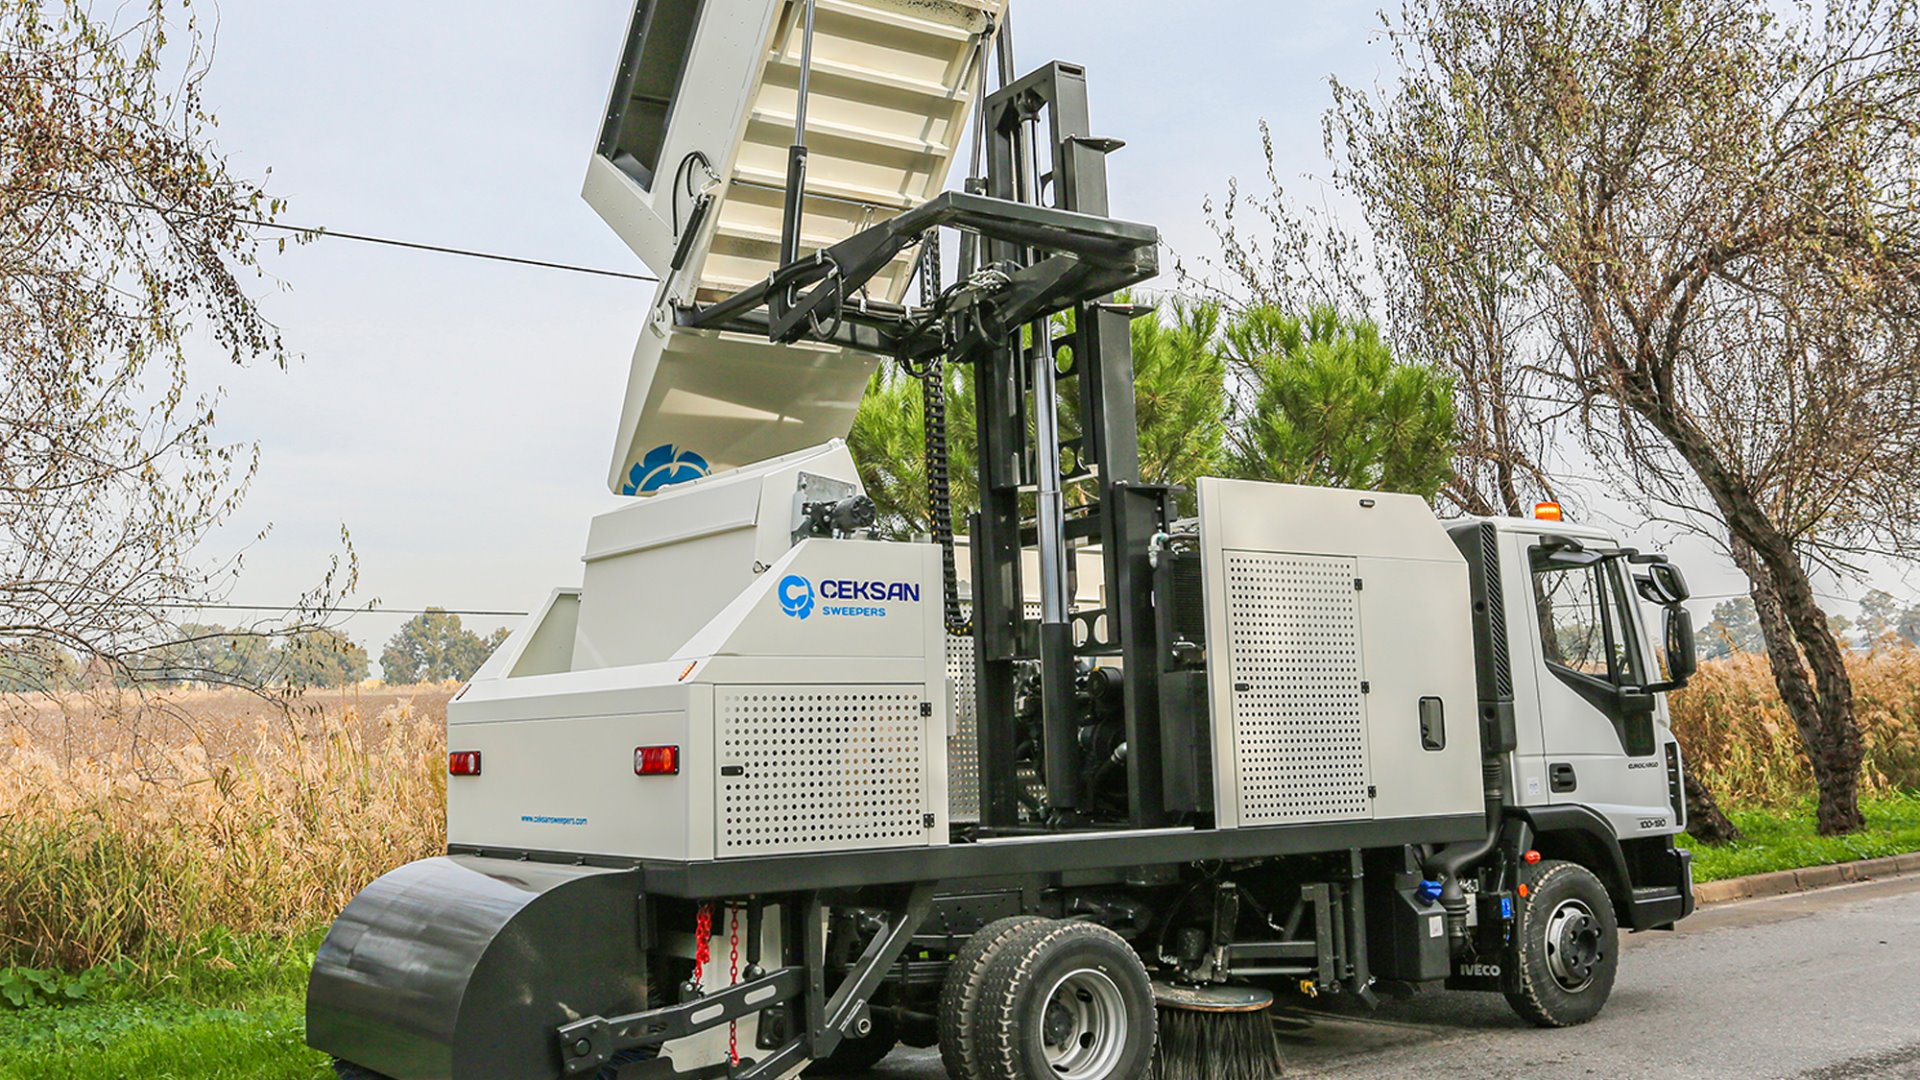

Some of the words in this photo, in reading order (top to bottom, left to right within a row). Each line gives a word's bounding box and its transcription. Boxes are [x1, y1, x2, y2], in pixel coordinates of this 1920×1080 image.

[820, 580, 920, 602] CEKSAN
[822, 606, 886, 617] SWEEPERS
[1460, 964, 1501, 977] IVECO
